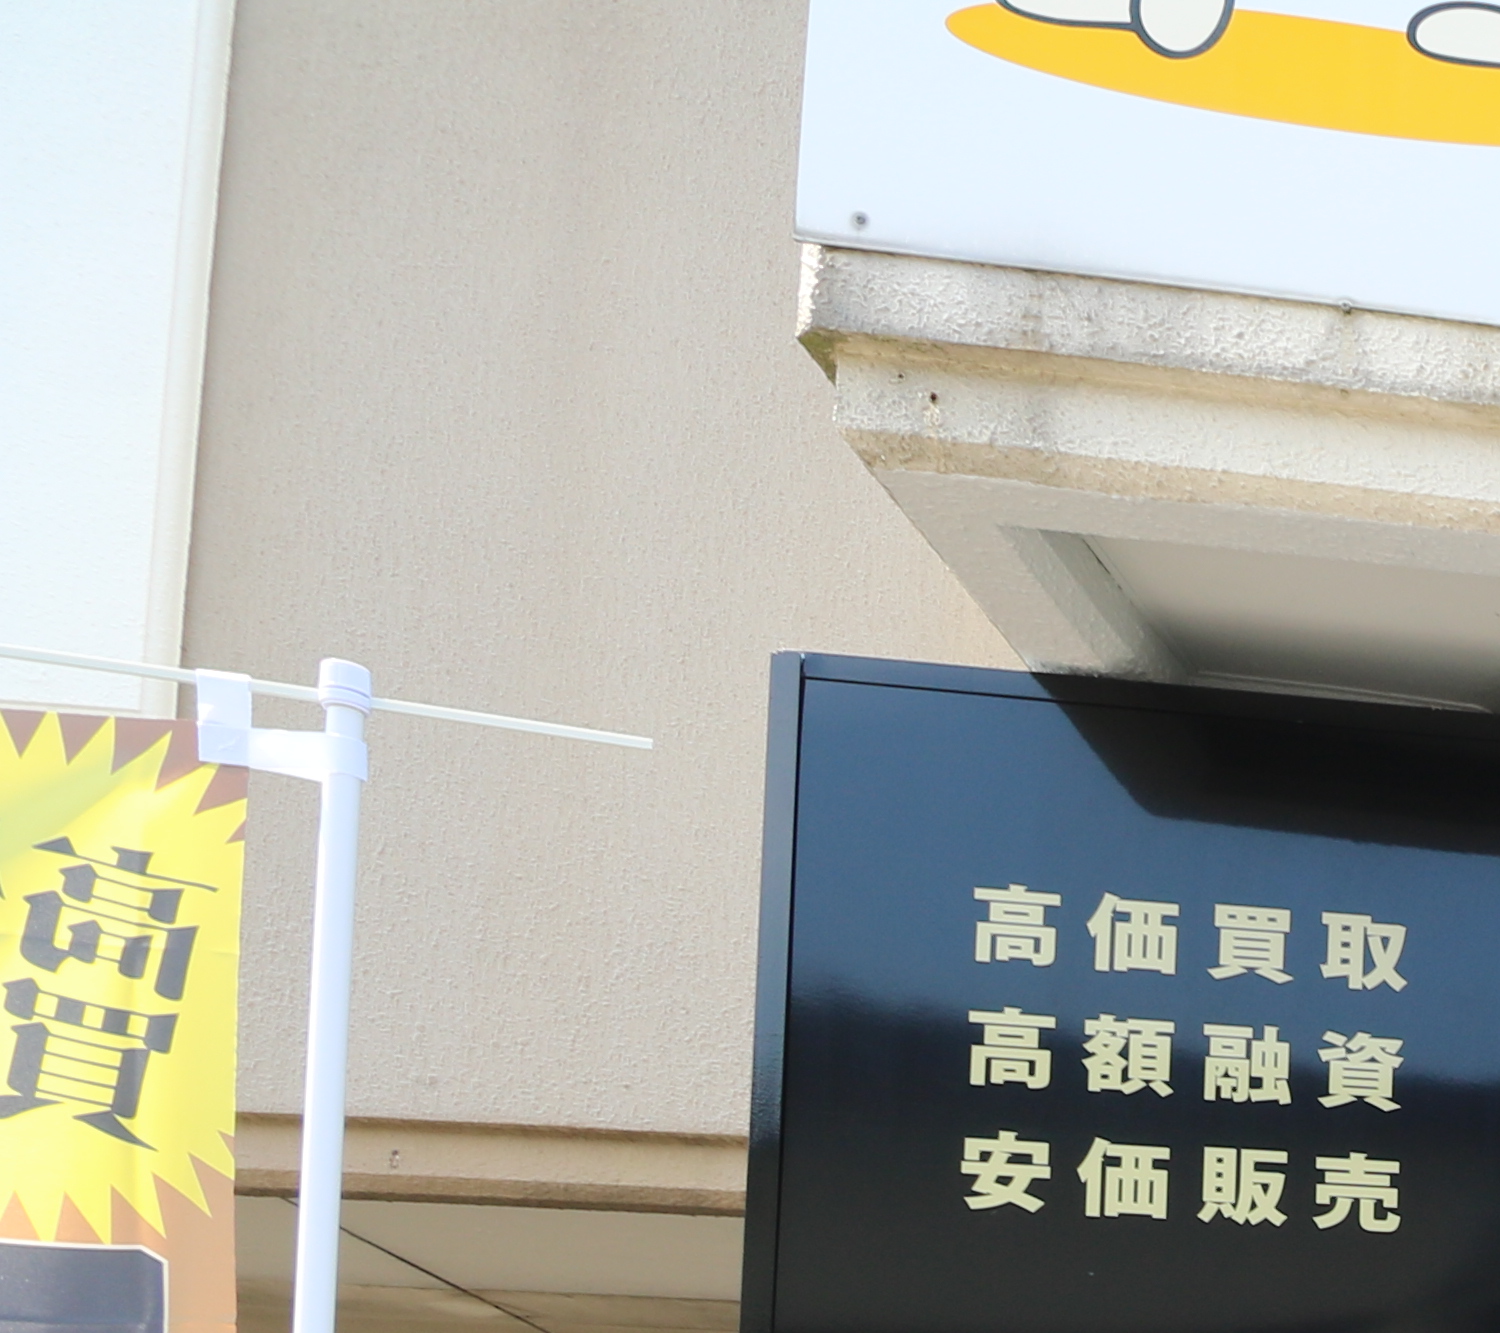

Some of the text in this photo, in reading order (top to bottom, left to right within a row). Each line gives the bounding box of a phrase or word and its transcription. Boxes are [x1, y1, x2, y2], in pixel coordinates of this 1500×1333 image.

[973, 884, 1408, 992] 高価買取
[968, 1007, 1404, 1112] 高額融資
[960, 1131, 1401, 1233] 安価販売
